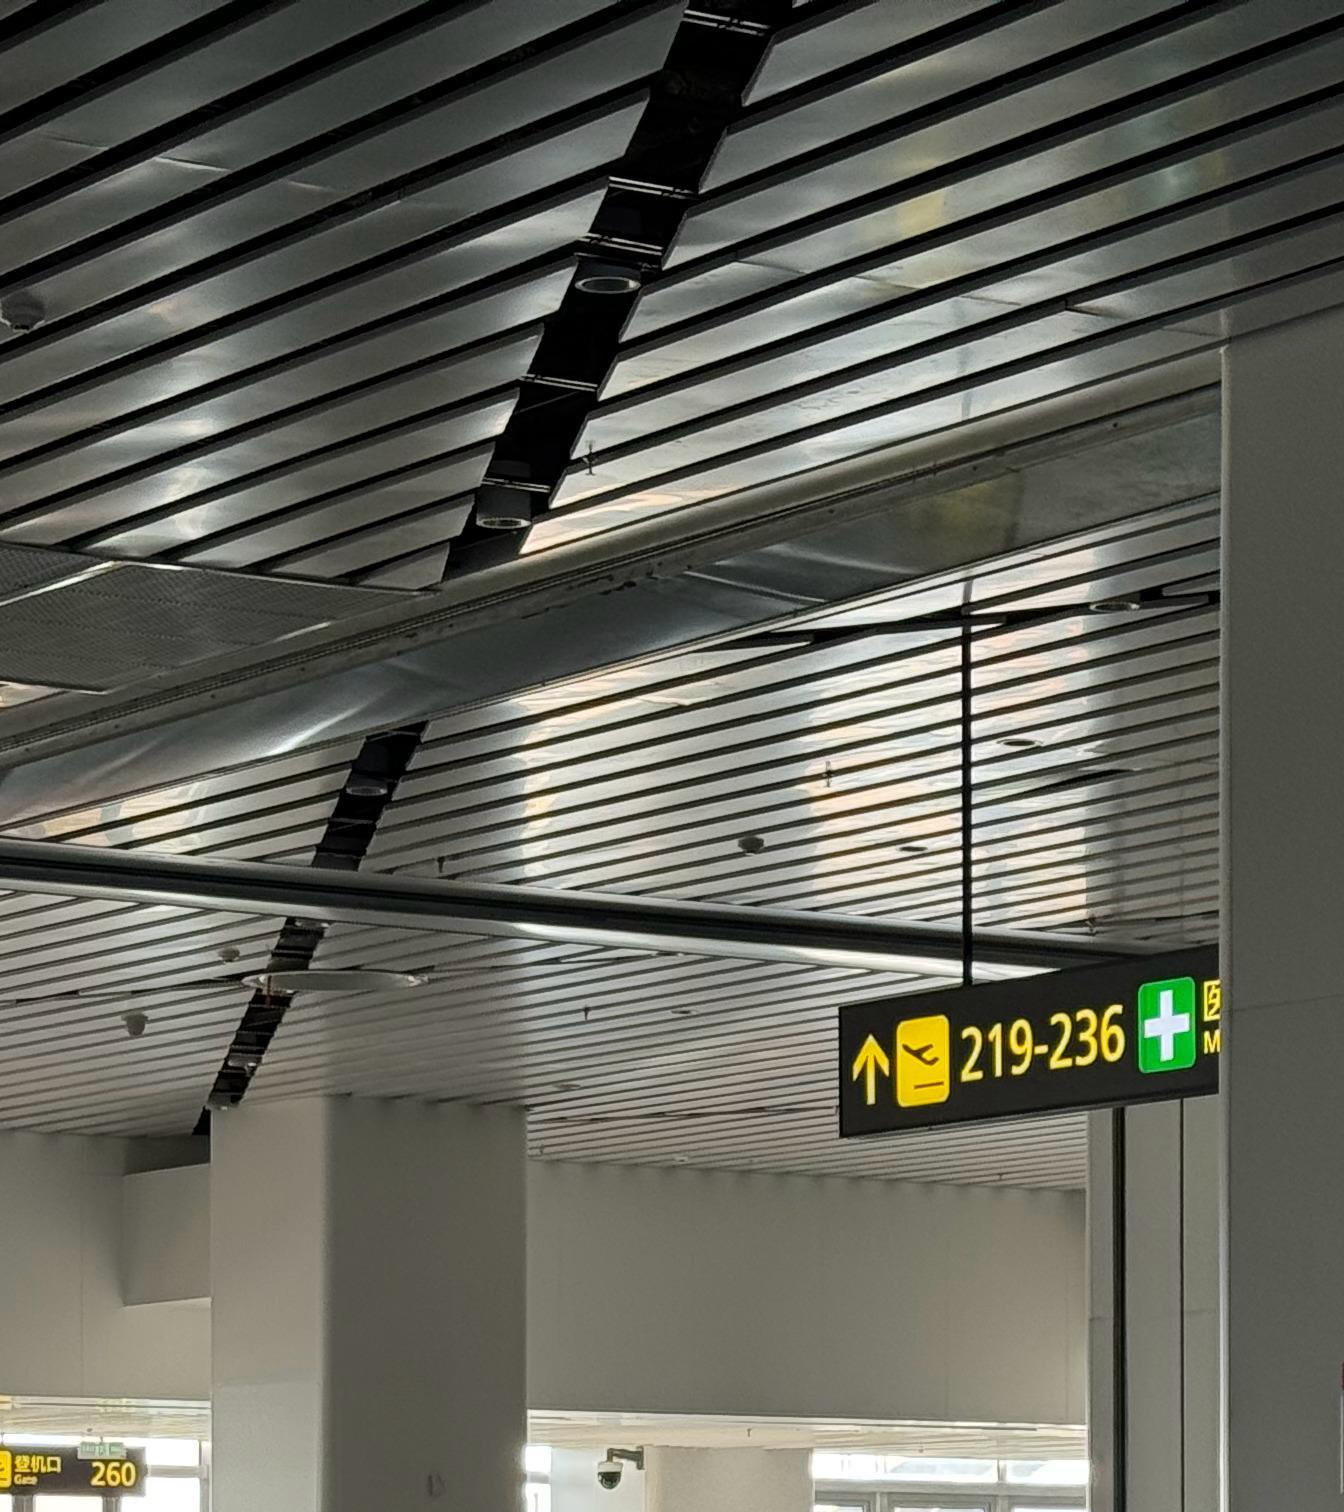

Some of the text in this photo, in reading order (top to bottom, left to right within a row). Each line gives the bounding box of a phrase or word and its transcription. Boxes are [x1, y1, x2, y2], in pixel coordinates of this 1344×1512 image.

[960, 1004, 1126, 1083] 219-236
[14, 1455, 61, 1473] 登机口
[90, 1461, 136, 1487] 260
